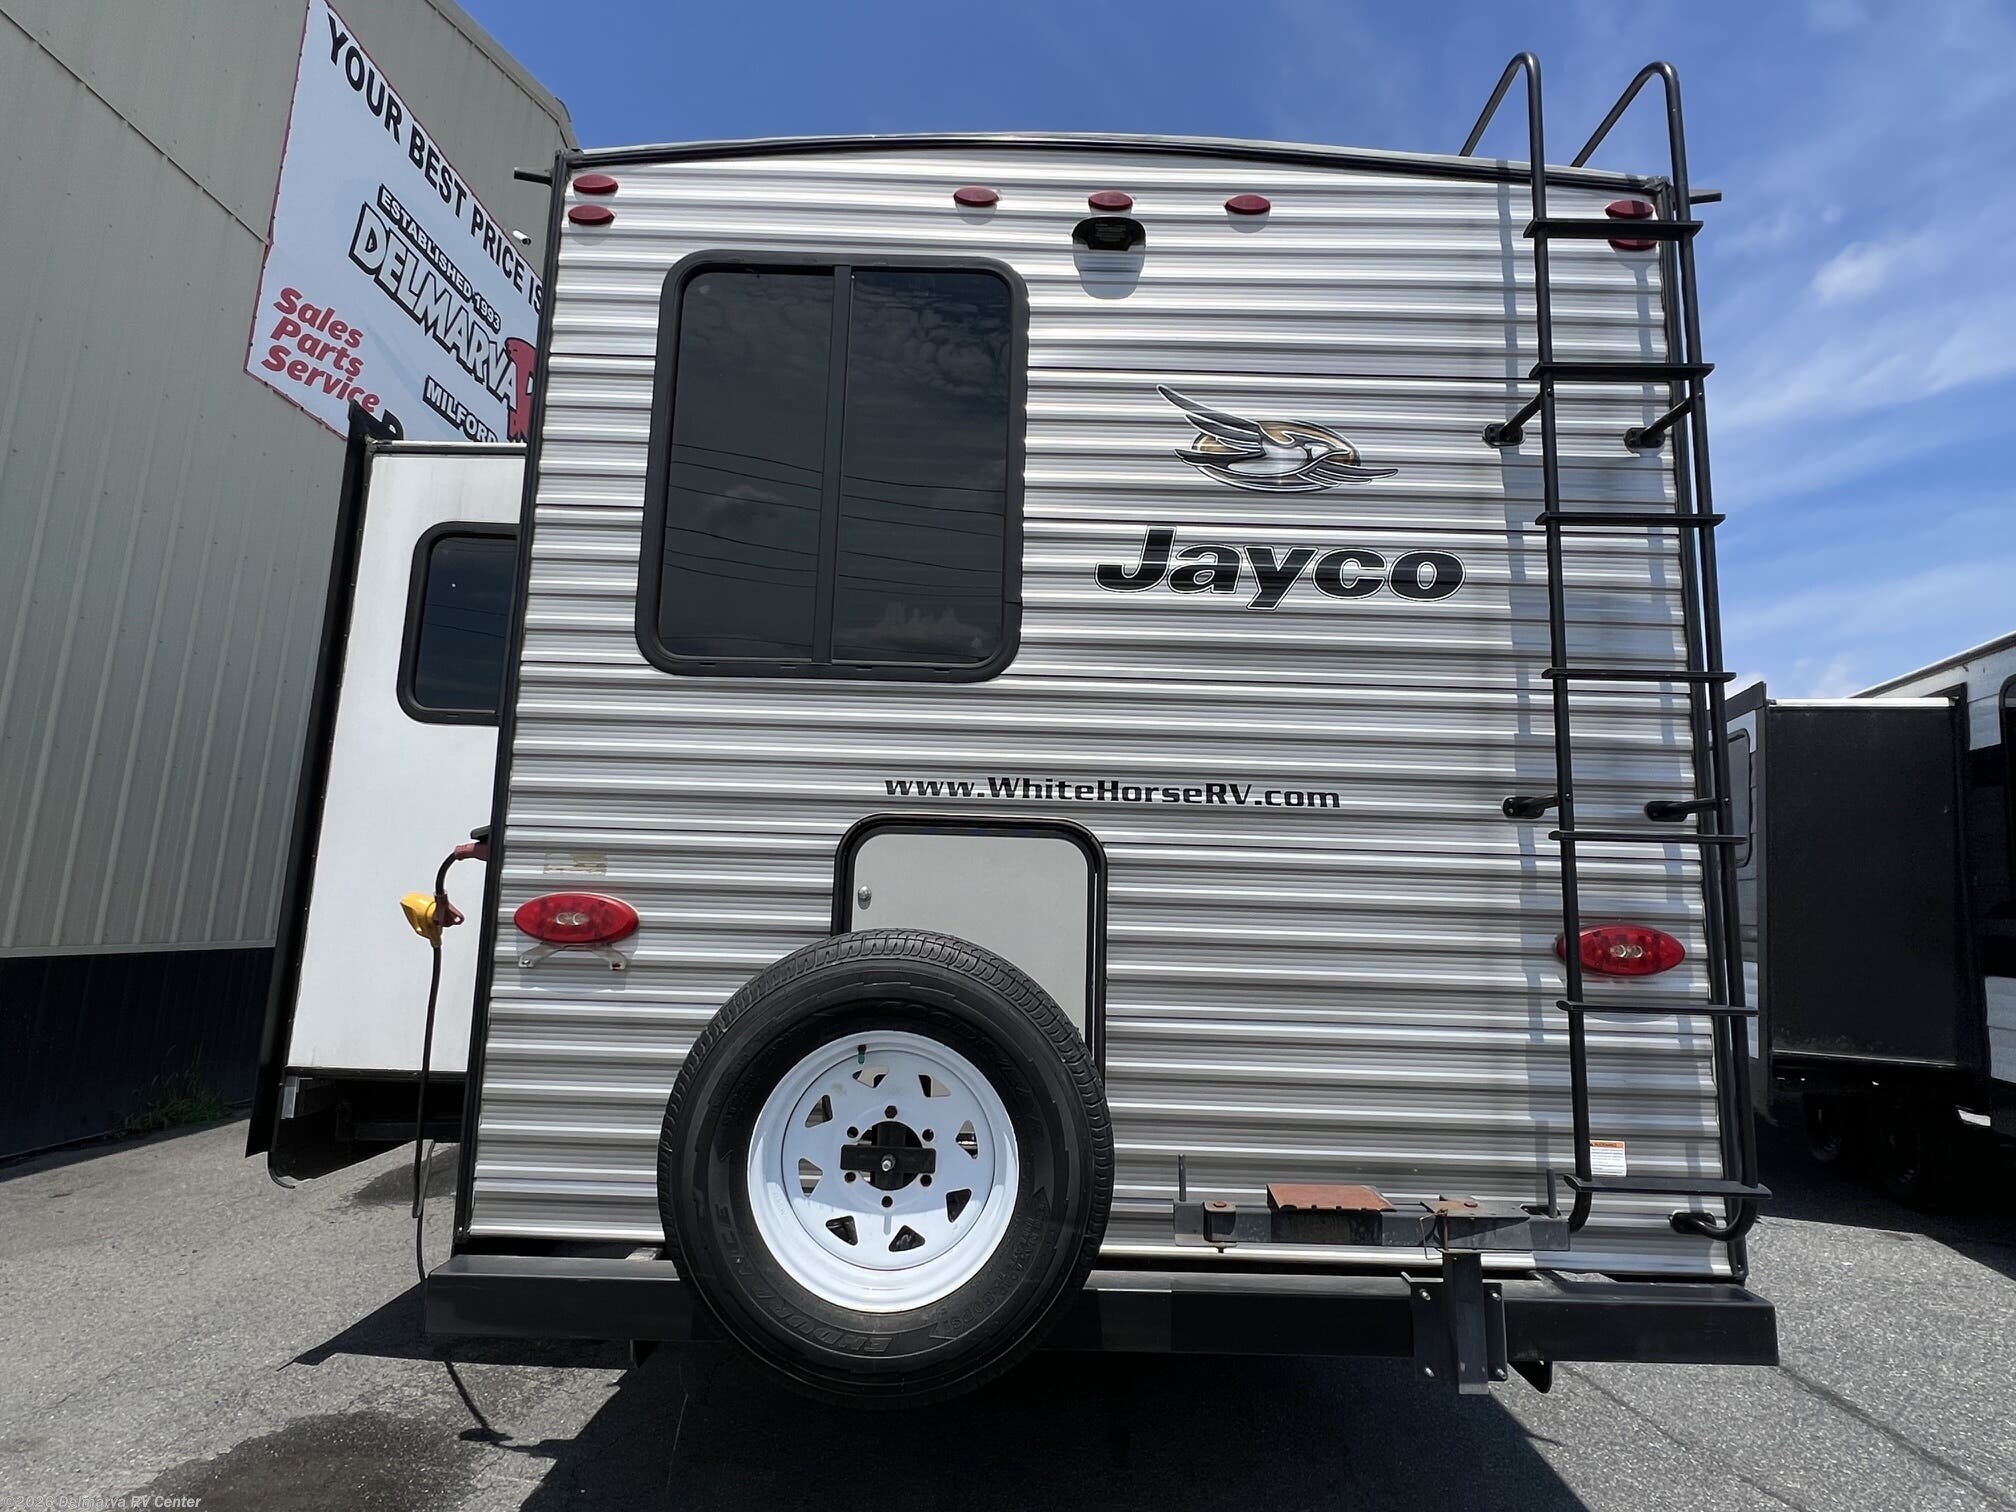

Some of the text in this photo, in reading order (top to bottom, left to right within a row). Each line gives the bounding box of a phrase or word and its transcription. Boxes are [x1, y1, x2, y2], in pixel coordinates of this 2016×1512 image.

[327, 12, 402, 145] YOUR
[408, 123, 467, 219] BEST
[470, 203, 524, 294] PRICE
[378, 185, 500, 333] ESTABLISHED 1993
[273, 288, 363, 348] Sales
[349, 202, 517, 412] DELMARVA
[261, 345, 380, 413] Service
[270, 316, 364, 377] Parts
[1094, 525, 1467, 611] Jayco
[885, 776, 1341, 808] www.WhiteHorseRV.com
